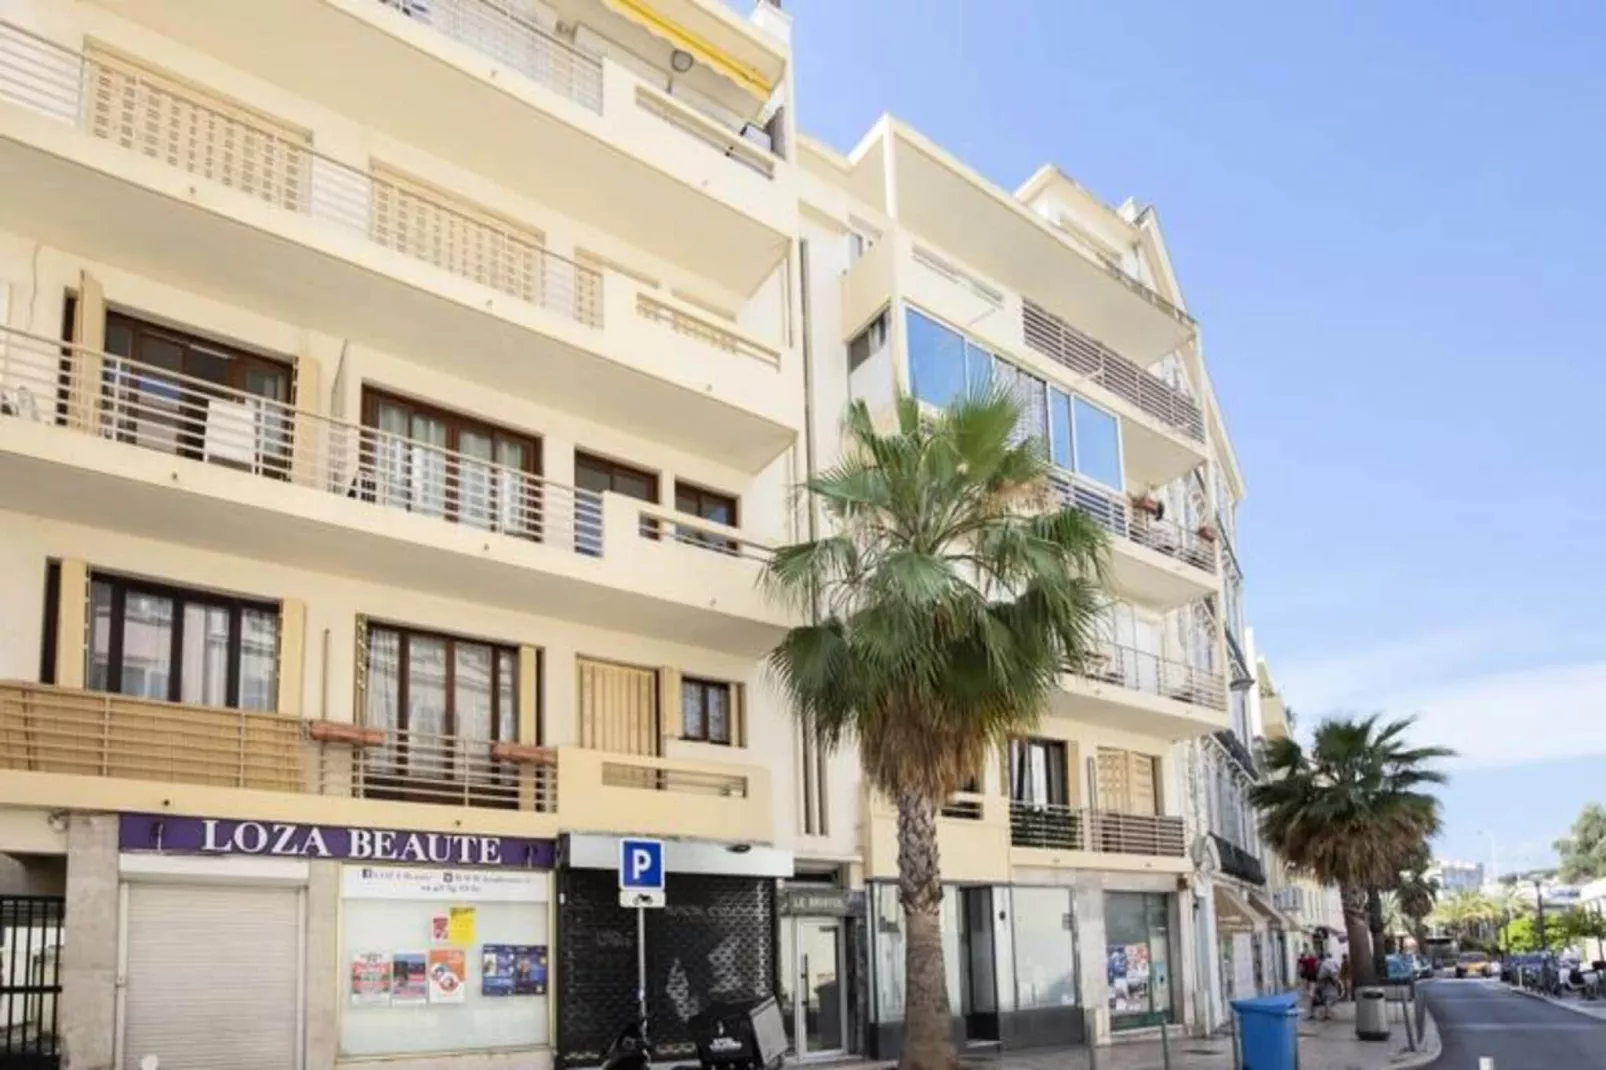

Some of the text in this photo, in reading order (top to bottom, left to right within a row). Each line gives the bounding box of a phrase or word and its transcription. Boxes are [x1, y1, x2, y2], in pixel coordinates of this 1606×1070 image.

[202, 820, 502, 864] LOZA BEAUTE
[632, 849, 652, 879] P
